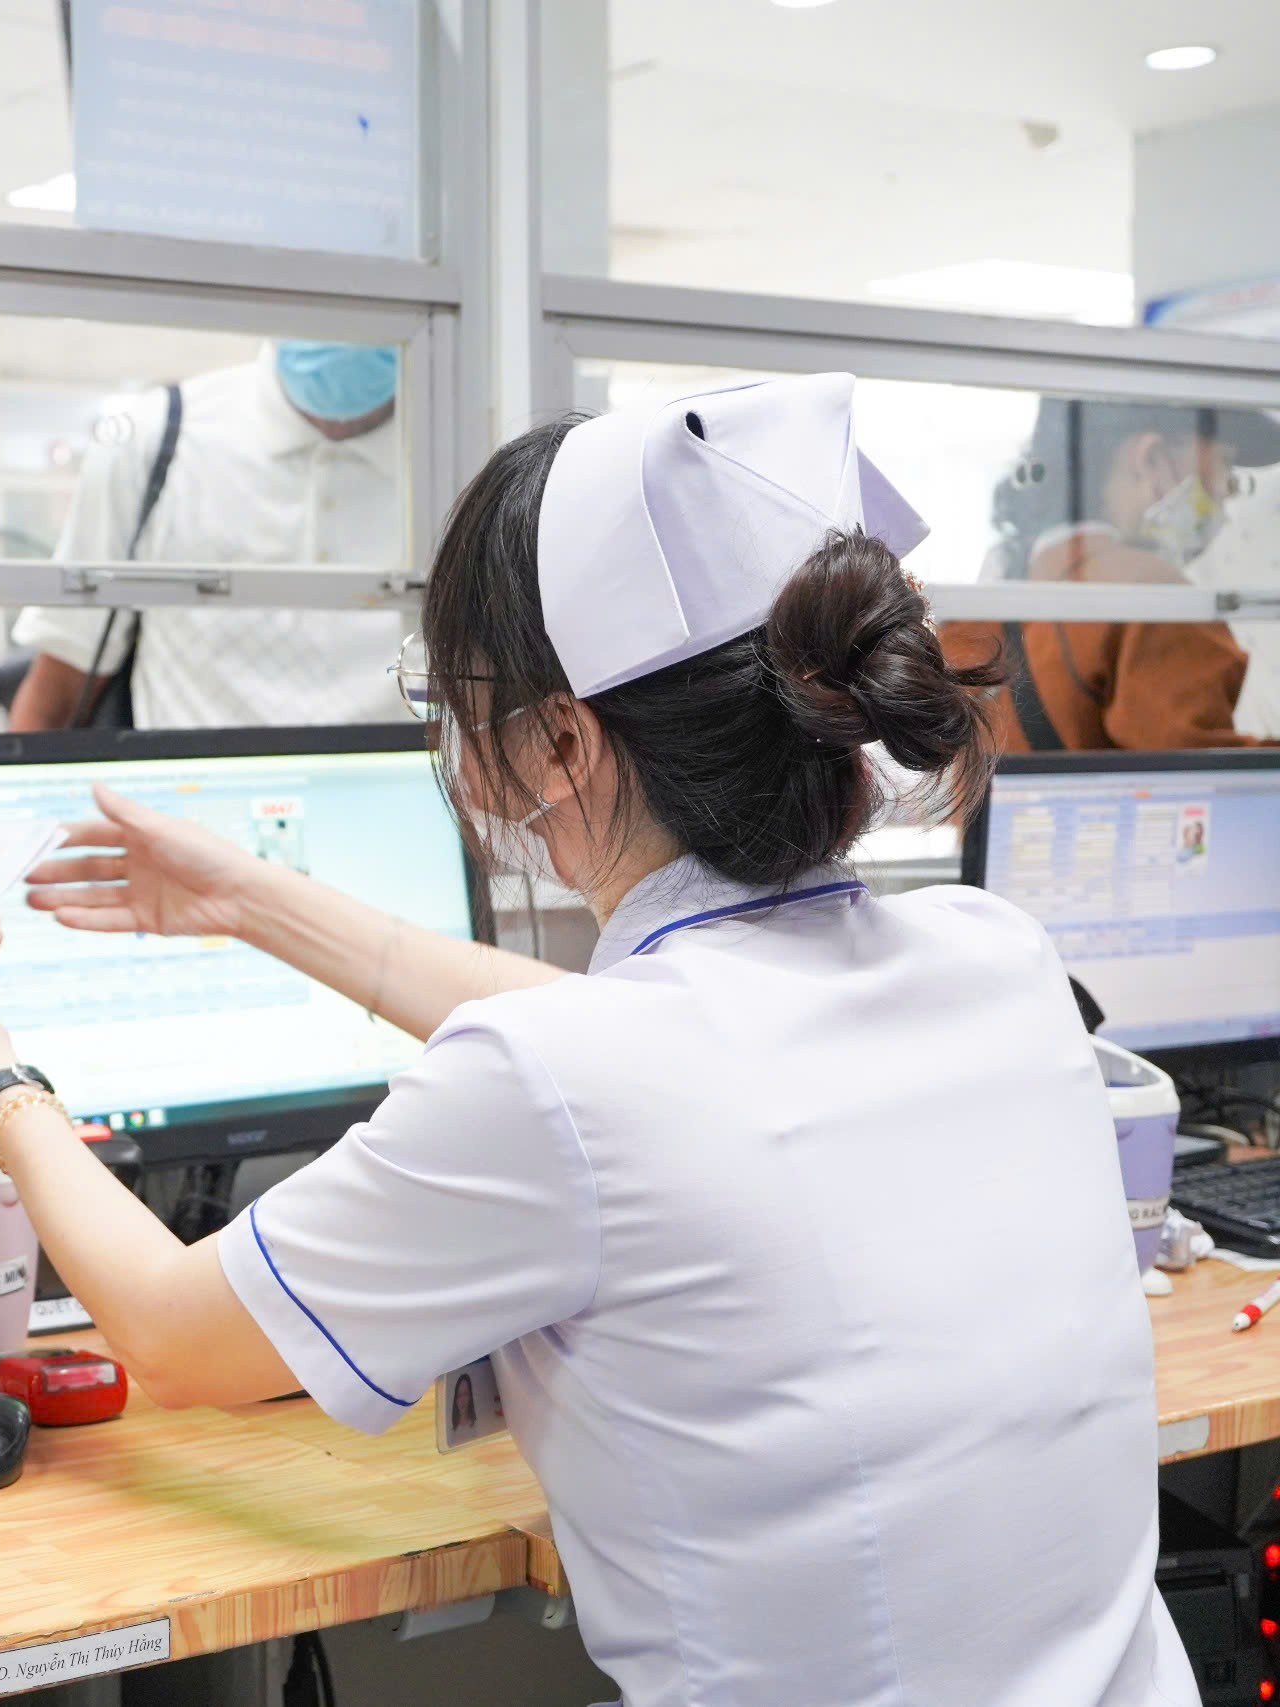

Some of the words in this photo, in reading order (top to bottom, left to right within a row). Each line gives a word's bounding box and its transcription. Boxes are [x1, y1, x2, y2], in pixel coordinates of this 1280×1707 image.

[15, 1652, 65, 1680] Nguyễn
[69, 1650, 90, 1667] Thị
[128, 1633, 163, 1655] Hằng
